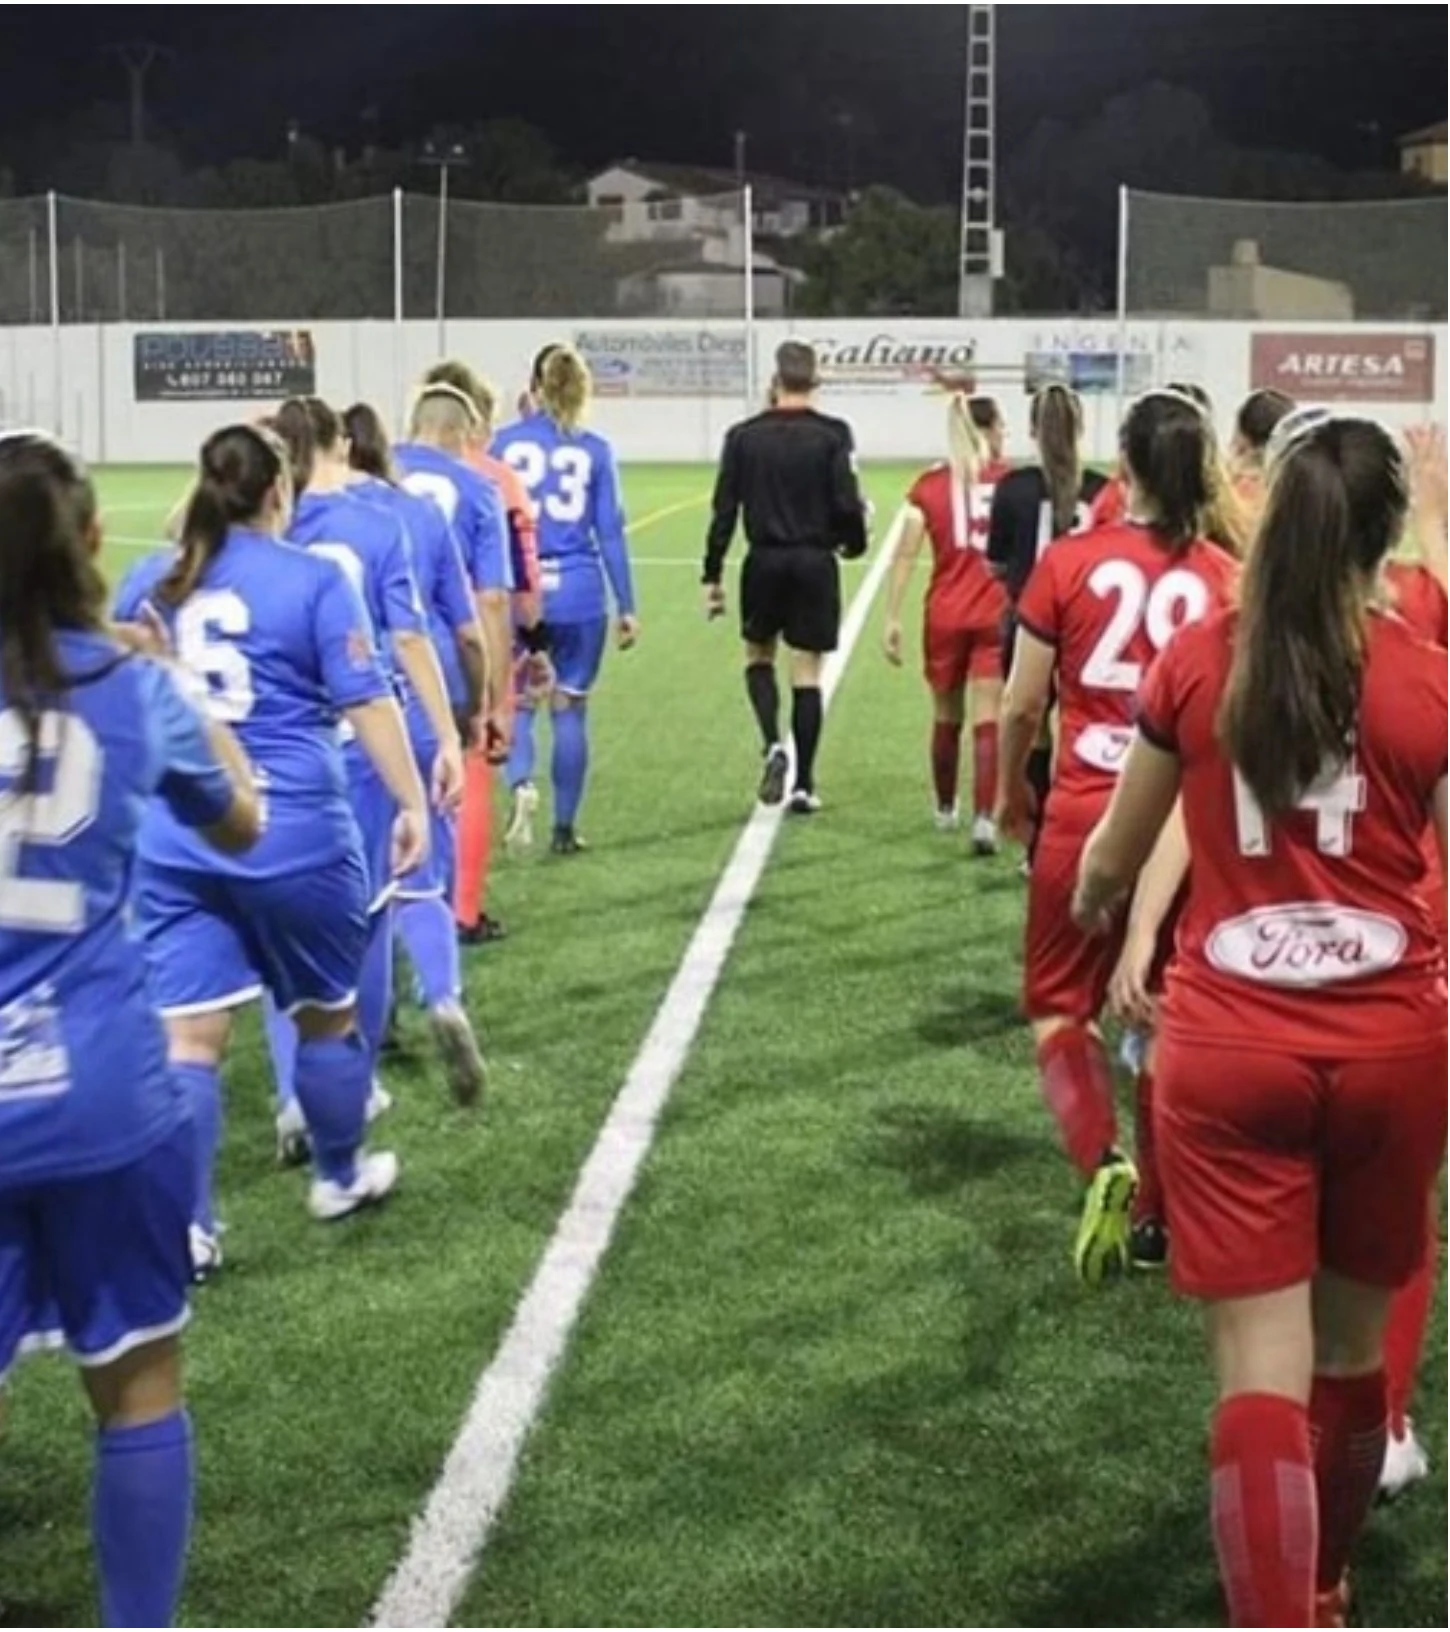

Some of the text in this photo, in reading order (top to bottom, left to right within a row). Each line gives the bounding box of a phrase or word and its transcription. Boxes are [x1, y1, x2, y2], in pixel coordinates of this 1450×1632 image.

[1276, 353, 1405, 375] ARTESA
[502, 440, 593, 523] 23
[1250, 917, 1365, 969] Ford
